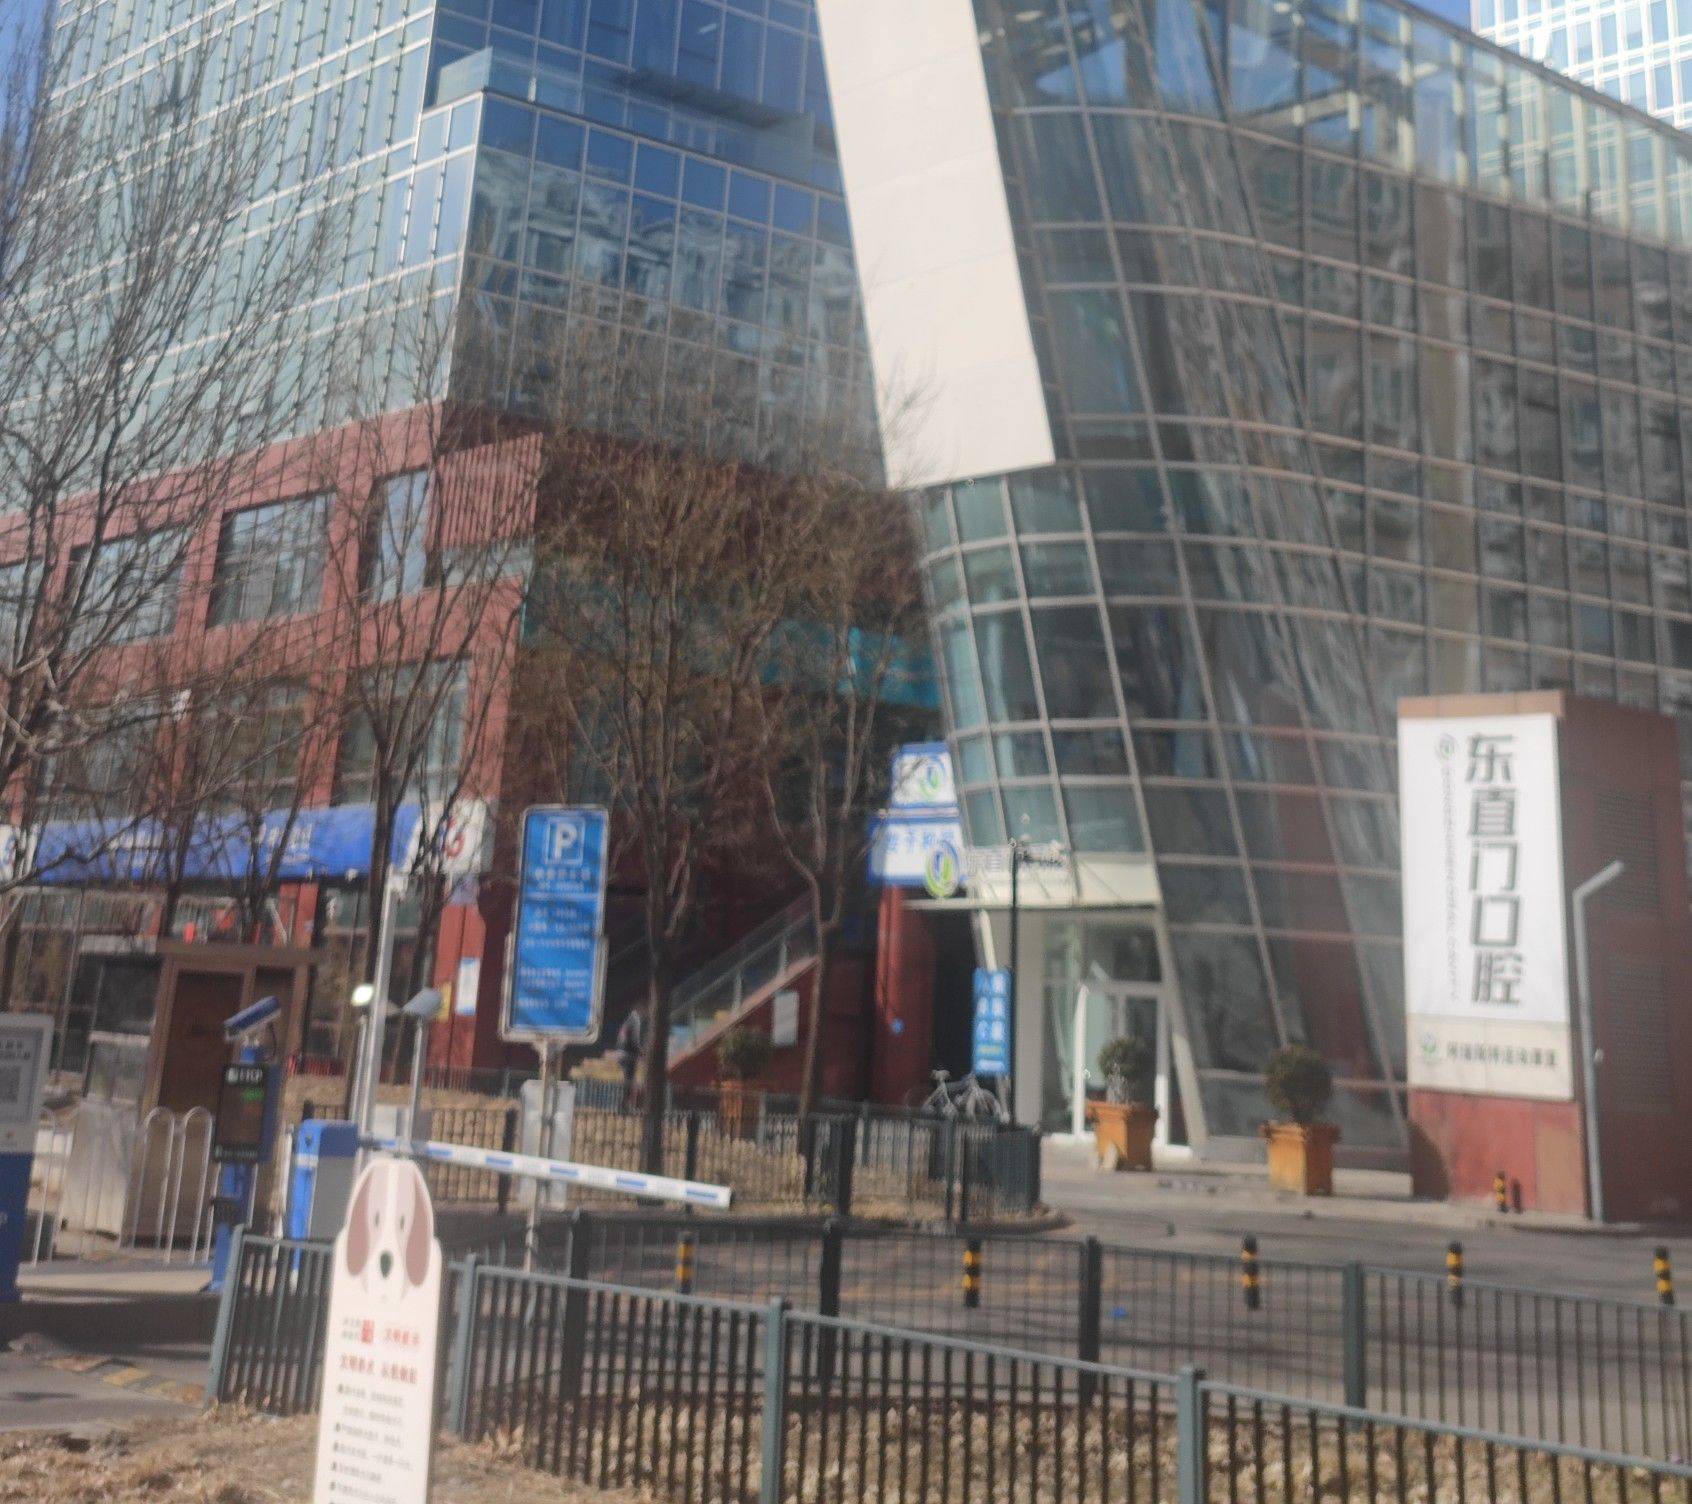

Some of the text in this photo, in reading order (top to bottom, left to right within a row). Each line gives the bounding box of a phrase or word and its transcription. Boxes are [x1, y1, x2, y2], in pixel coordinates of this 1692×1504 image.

[553, 822, 579, 859] P
[1464, 733, 1525, 1006] 东直门口腔
